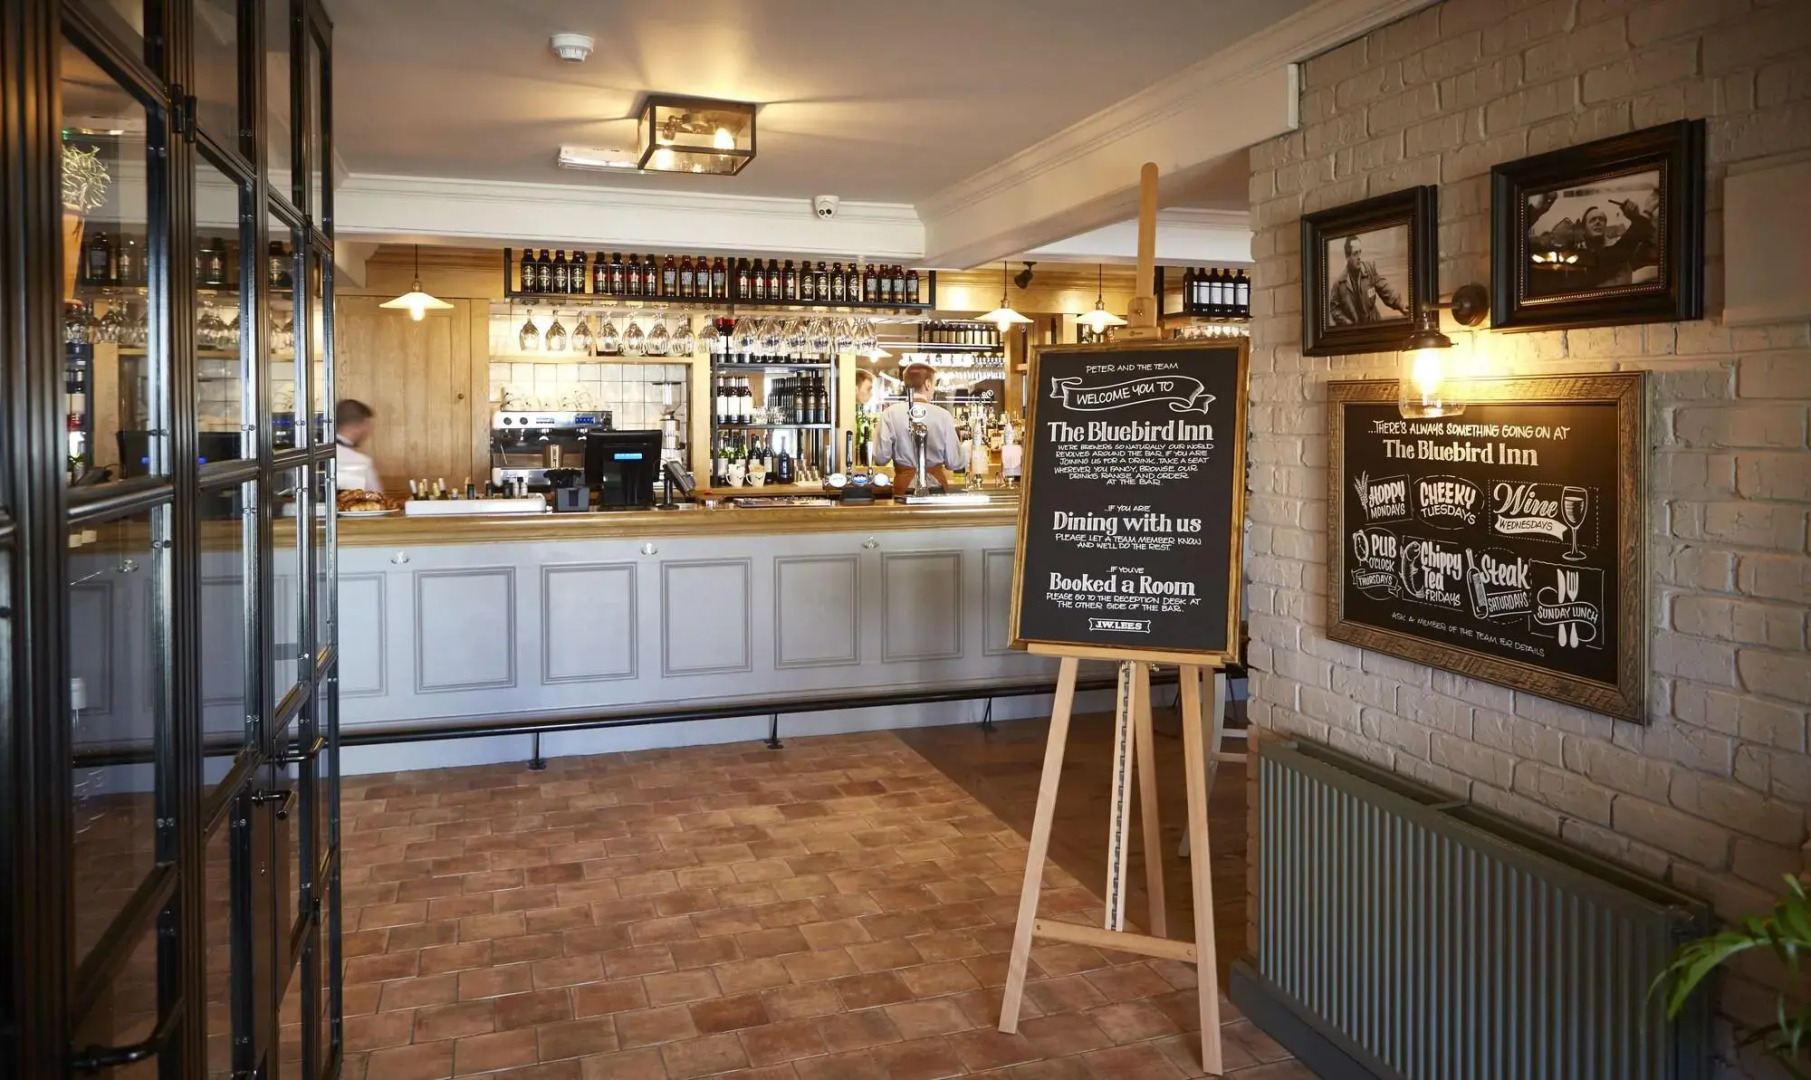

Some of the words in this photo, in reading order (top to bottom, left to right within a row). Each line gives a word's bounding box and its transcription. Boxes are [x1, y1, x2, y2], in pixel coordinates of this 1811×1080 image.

[1086, 364, 1115, 374] PETER
[1077, 390, 1130, 405] WELCOME
[1132, 383, 1154, 396] YOU
[1156, 381, 1174, 392] TO
[1048, 421, 1084, 442] The
[1088, 420, 1174, 442] Bluebird
[1178, 420, 1214, 441] Inn
[1410, 422, 1444, 436] ALWAYS
[1446, 423, 1499, 438] SOMETHING
[1502, 425, 1533, 438] GOING
[1535, 426, 1550, 439] ON
[1554, 426, 1570, 440] AT
[1383, 439, 1415, 459] The
[1418, 440, 1494, 464] Bluebird
[1499, 443, 1538, 466] Inn
[1054, 466, 1090, 474] WHEREVER
[1369, 481, 1405, 508] HOPPY
[1420, 482, 1476, 510] CHEEKY
[1493, 483, 1558, 518] Wine
[1370, 503, 1406, 519] MONDAYS
[1420, 504, 1476, 525] TUESDAYS
[1053, 511, 1118, 536] Dining
[1123, 513, 1172, 532] with
[1177, 518, 1201, 532] us
[1499, 519, 1553, 532] WEDNESDAYS
[1056, 533, 1086, 541] PLEASE
[1371, 534, 1396, 558] PUB
[1369, 557, 1395, 572] O'CLOCK
[1420, 541, 1462, 580] Chippy
[1358, 575, 1393, 586] THURSDAYS
[1422, 565, 1444, 591] Tea
[1480, 554, 1531, 589] Steak
[1050, 572, 1116, 593] Booked
[1122, 580, 1135, 593] a
[1140, 576, 1195, 596] Room
[1046, 592, 1073, 600] PLEASE
[1114, 596, 1159, 604] RECEPTION
[1163, 597, 1186, 605] DESK
[1425, 589, 1461, 606] FRIDAYS
[1488, 592, 1529, 612] SATURDAYS
[1537, 606, 1570, 619] SUNDAY
[1572, 607, 1598, 624] LUNCH
[1391, 611, 1406, 622] ASK
[1417, 618, 1446, 631] MEMBER
[1459, 627, 1473, 637] THE
[1476, 631, 1498, 644] TEAM
[1514, 642, 1545, 657] DETAILS
